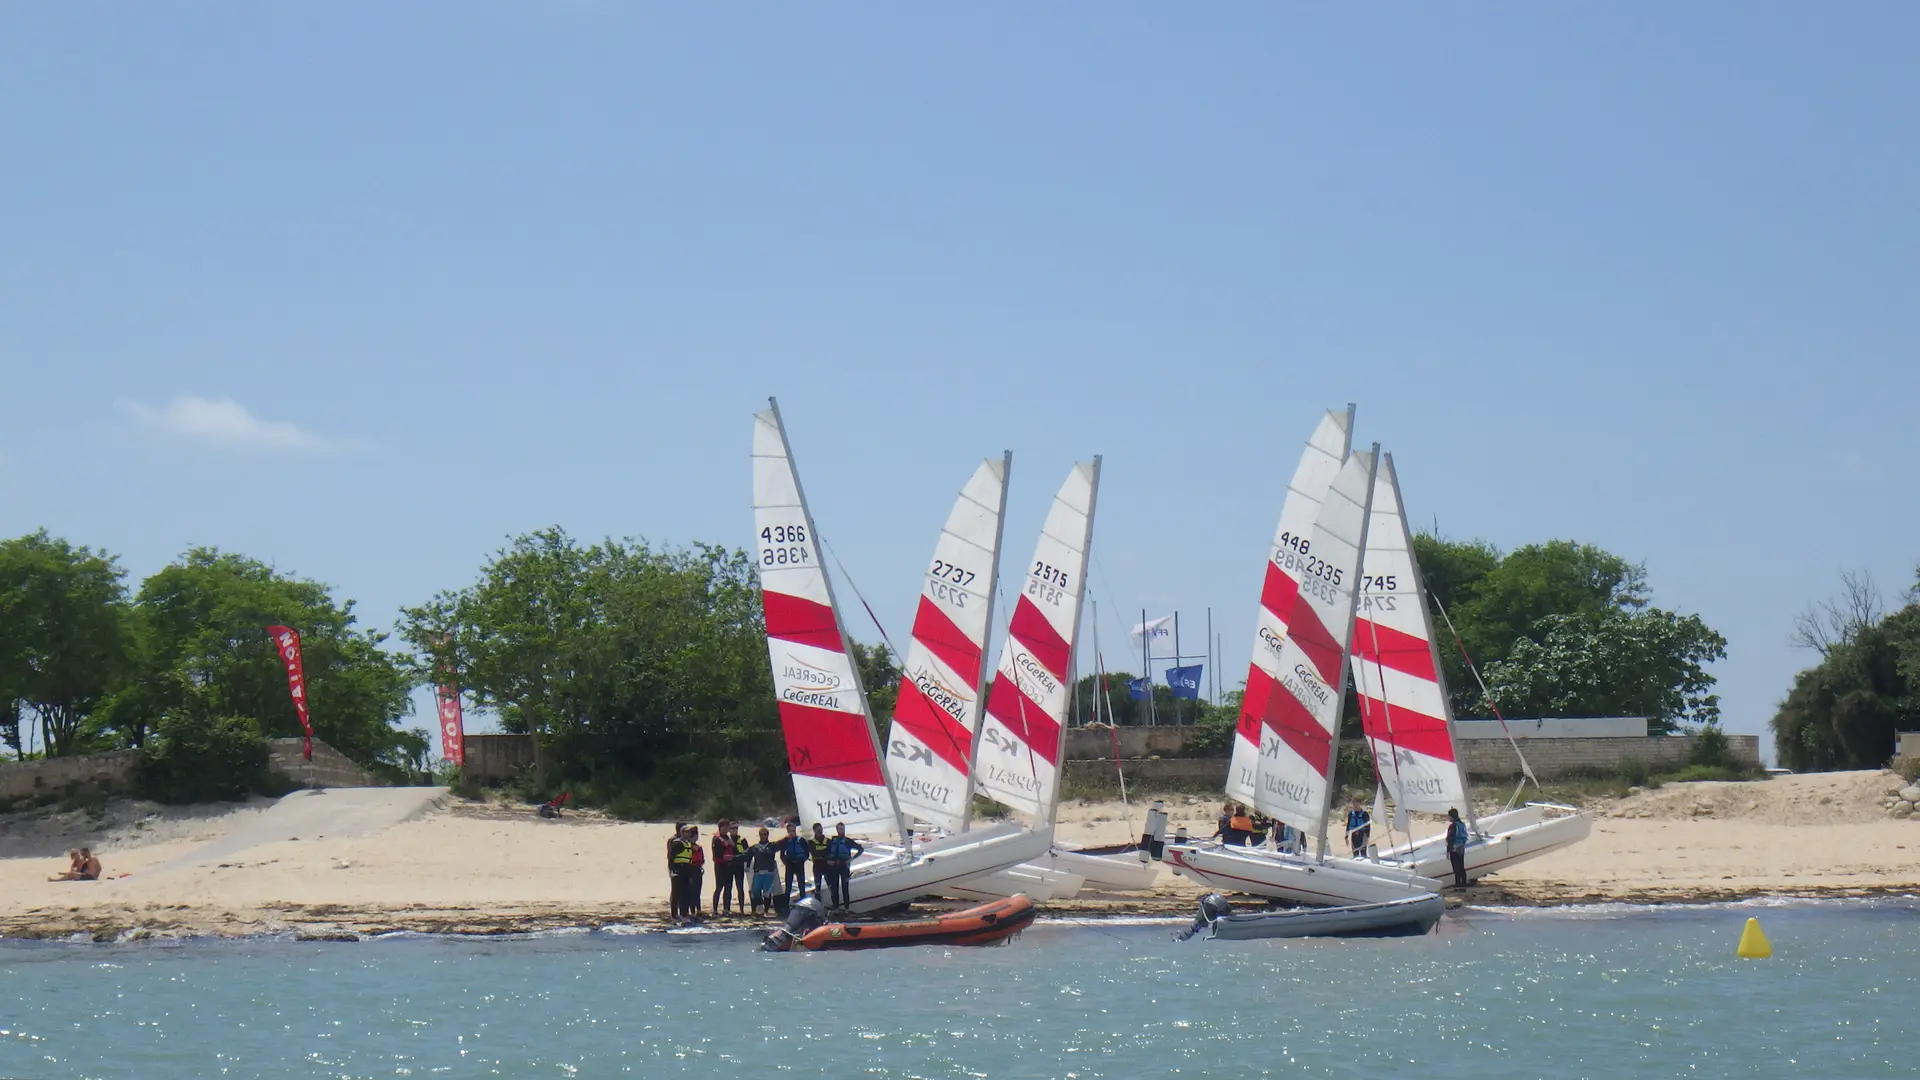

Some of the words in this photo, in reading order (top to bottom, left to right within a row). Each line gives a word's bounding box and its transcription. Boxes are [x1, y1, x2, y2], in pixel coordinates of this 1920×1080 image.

[761, 526, 806, 543] 4366
[932, 560, 975, 586] 2737
[1034, 561, 1068, 588] 2575
[1306, 556, 1344, 586] 2335
[1359, 576, 1397, 591] 745
[1017, 653, 1057, 694] CeGeREAL
[1294, 663, 1328, 705] CeGeREAL
[783, 688, 840, 709] CeGeREAL
[915, 675, 966, 723] CeGeREAL
